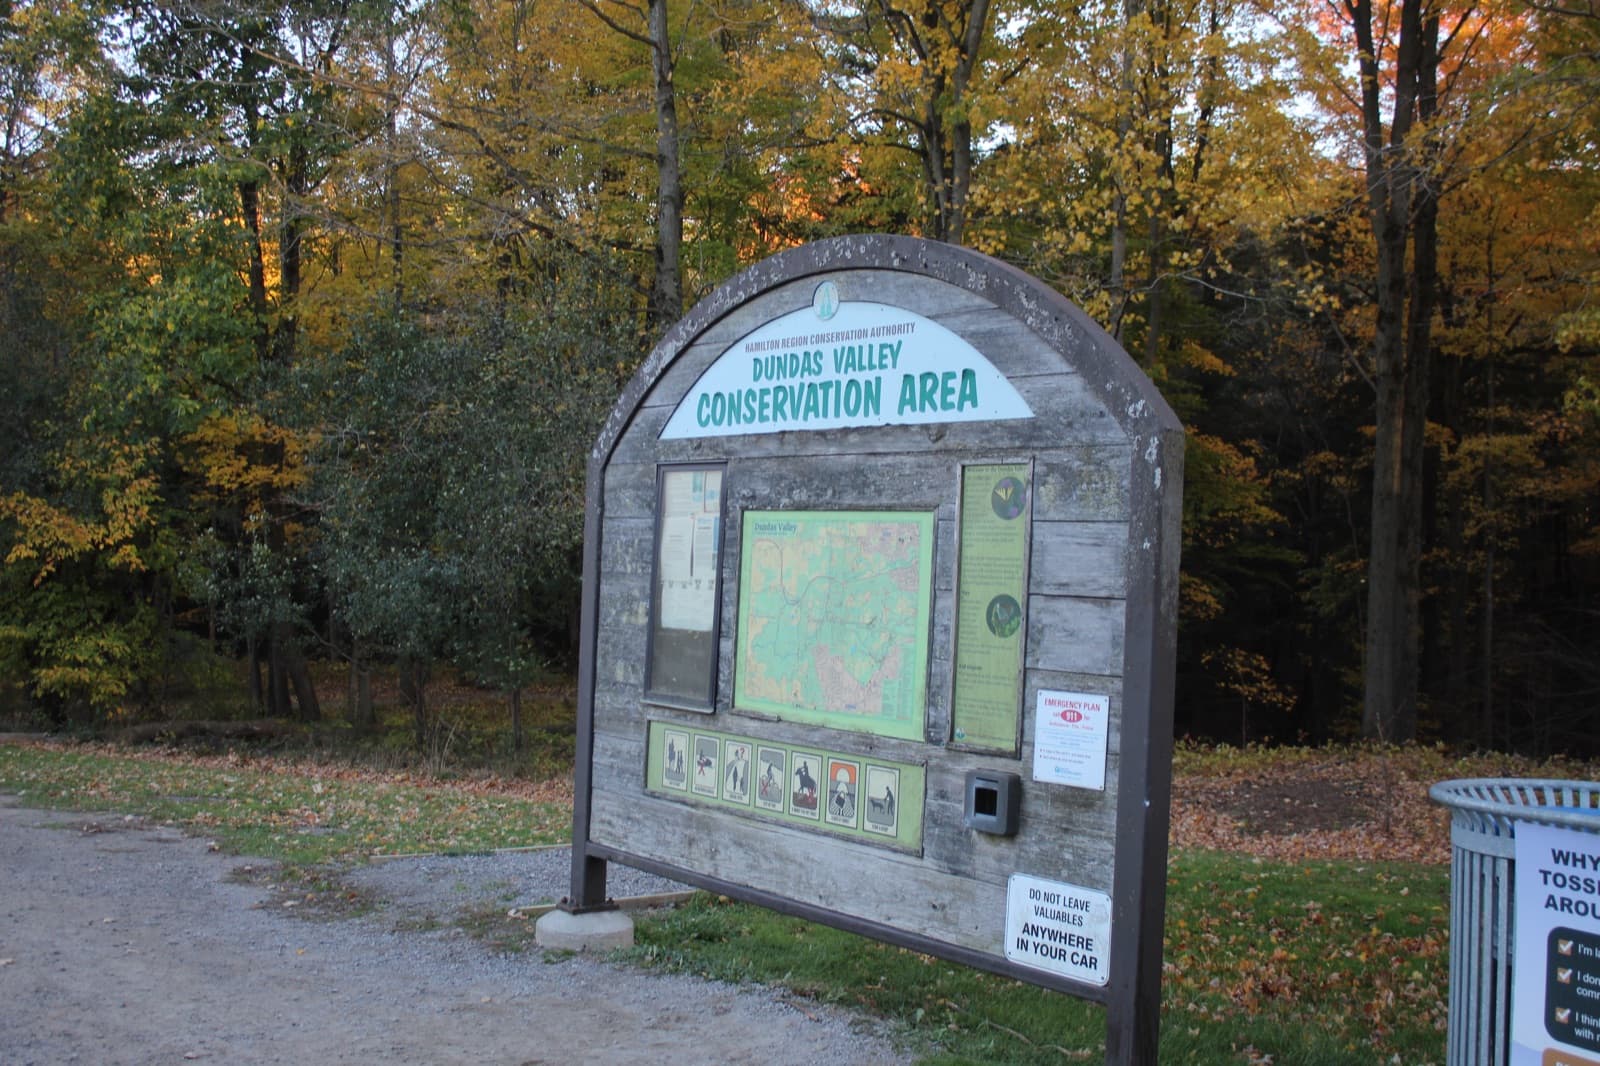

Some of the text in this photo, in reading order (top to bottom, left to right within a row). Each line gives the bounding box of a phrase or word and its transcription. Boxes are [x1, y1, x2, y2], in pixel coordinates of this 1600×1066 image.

[745, 322, 916, 353] HAMILTON REGION CONSERVATION AUTHORITY
[752, 339, 903, 382] DUNDAS VALLEY
[696, 368, 978, 428] CONSERVATION AREA
[754, 522, 797, 533] Dundas Valley
[1044, 697, 1100, 712] EMERGENCY PLAN
[1551, 848, 1600, 872] WHY
[1539, 869, 1600, 896] TOSS
[1029, 887, 1091, 912] DO NOT LEAVE
[1544, 894, 1600, 920] AROU
[1034, 905, 1083, 927] VALUABLES
[1022, 922, 1093, 952] ANYWHERE
[1016, 937, 1098, 970] IN YOUR CAR
[1578, 943, 1593, 956] I'm
[1577, 970, 1581, 981] I
[1575, 1011, 1600, 1029] I thin
[1574, 1027, 1594, 1041] with
